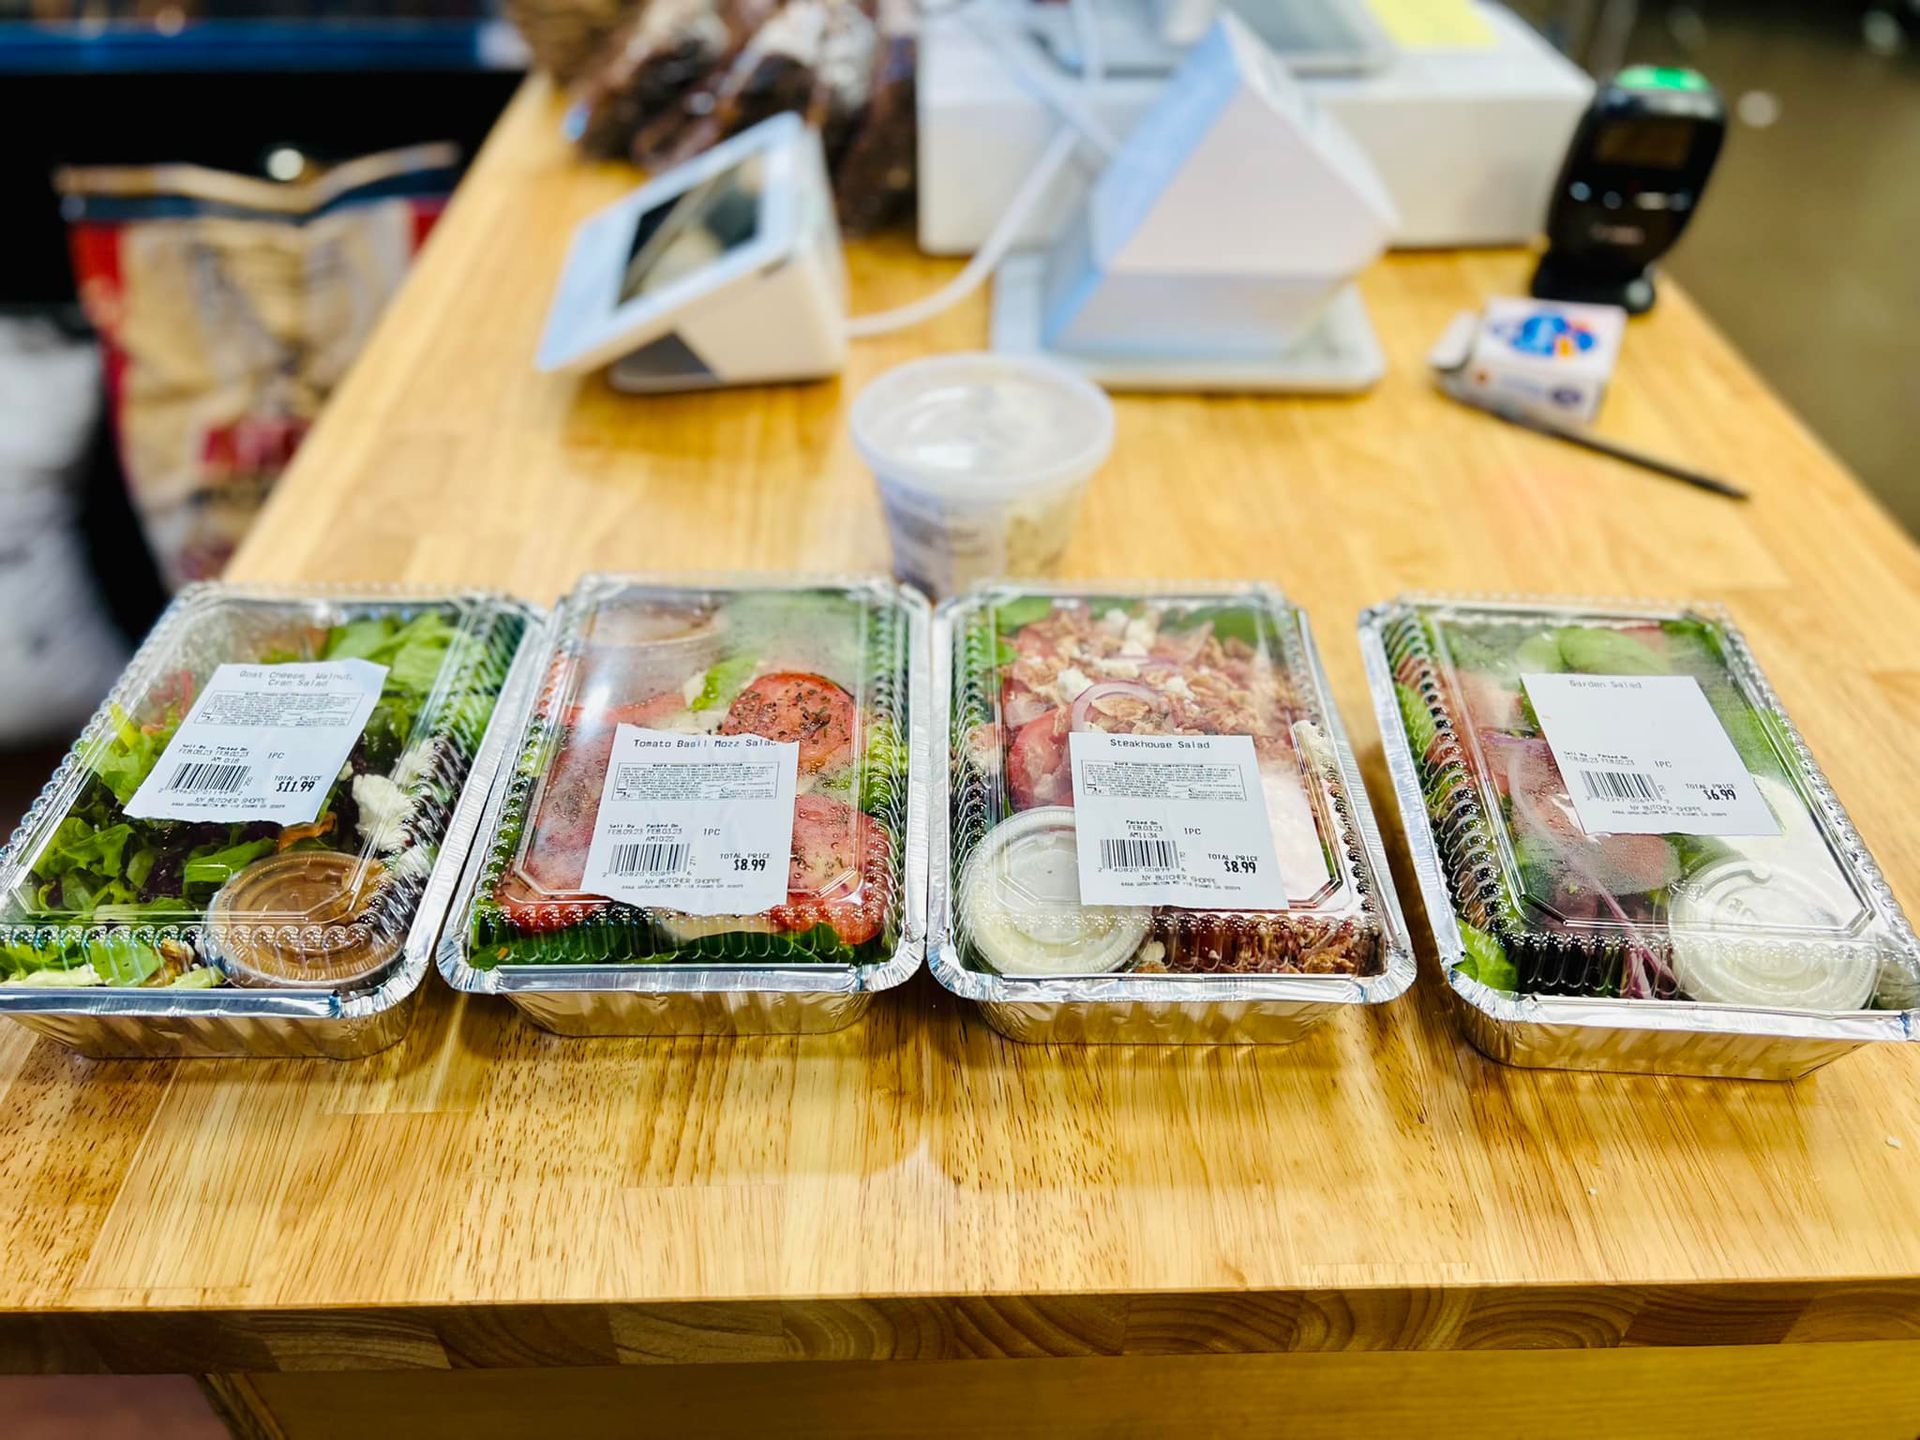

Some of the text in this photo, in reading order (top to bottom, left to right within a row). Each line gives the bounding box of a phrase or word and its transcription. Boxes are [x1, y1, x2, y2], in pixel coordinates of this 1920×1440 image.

[239, 671, 263, 679] Goat
[1568, 679, 1642, 689] Garden Salad
[633, 739, 672, 748] Tomato
[677, 739, 707, 748] Basil
[714, 739, 740, 748] Mozz
[1110, 738, 1210, 749] Steakhouse Salad
[1655, 760, 1672, 769] 1PC
[276, 780, 315, 793] $11.99
[1703, 789, 1737, 801] $6.99
[703, 828, 721, 837] 1PC
[1184, 827, 1201, 835] 1PC
[733, 858, 767, 871] $8.99
[1224, 860, 1257, 874] $8.99
